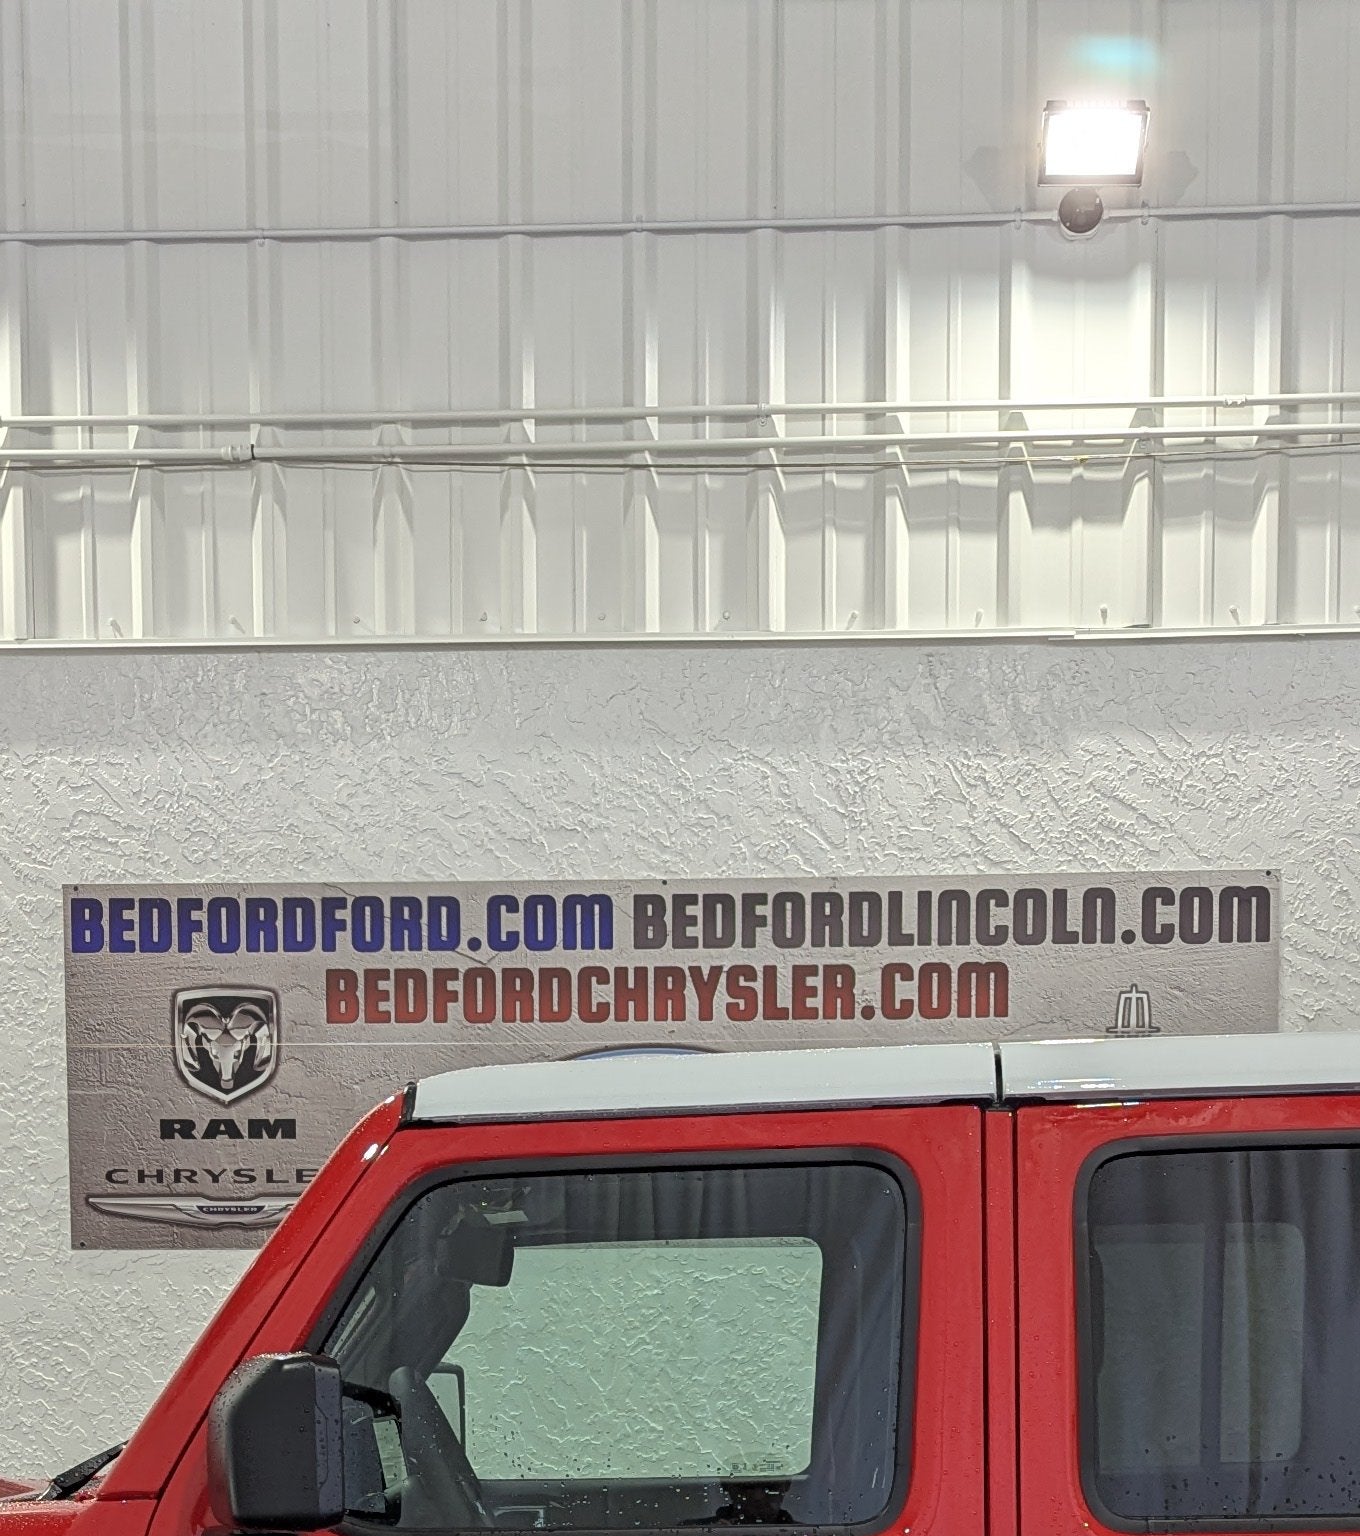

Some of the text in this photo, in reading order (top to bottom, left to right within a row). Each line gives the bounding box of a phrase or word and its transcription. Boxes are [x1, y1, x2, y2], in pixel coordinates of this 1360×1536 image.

[70, 885, 1272, 954] BEDFORDFORD.COM BEDFORDLINCOLN.COM
[325, 961, 1009, 1024] BEDFORDCHRYSLER.COM
[159, 1118, 297, 1140] RAM
[105, 1168, 319, 1184] CHRYSLE
